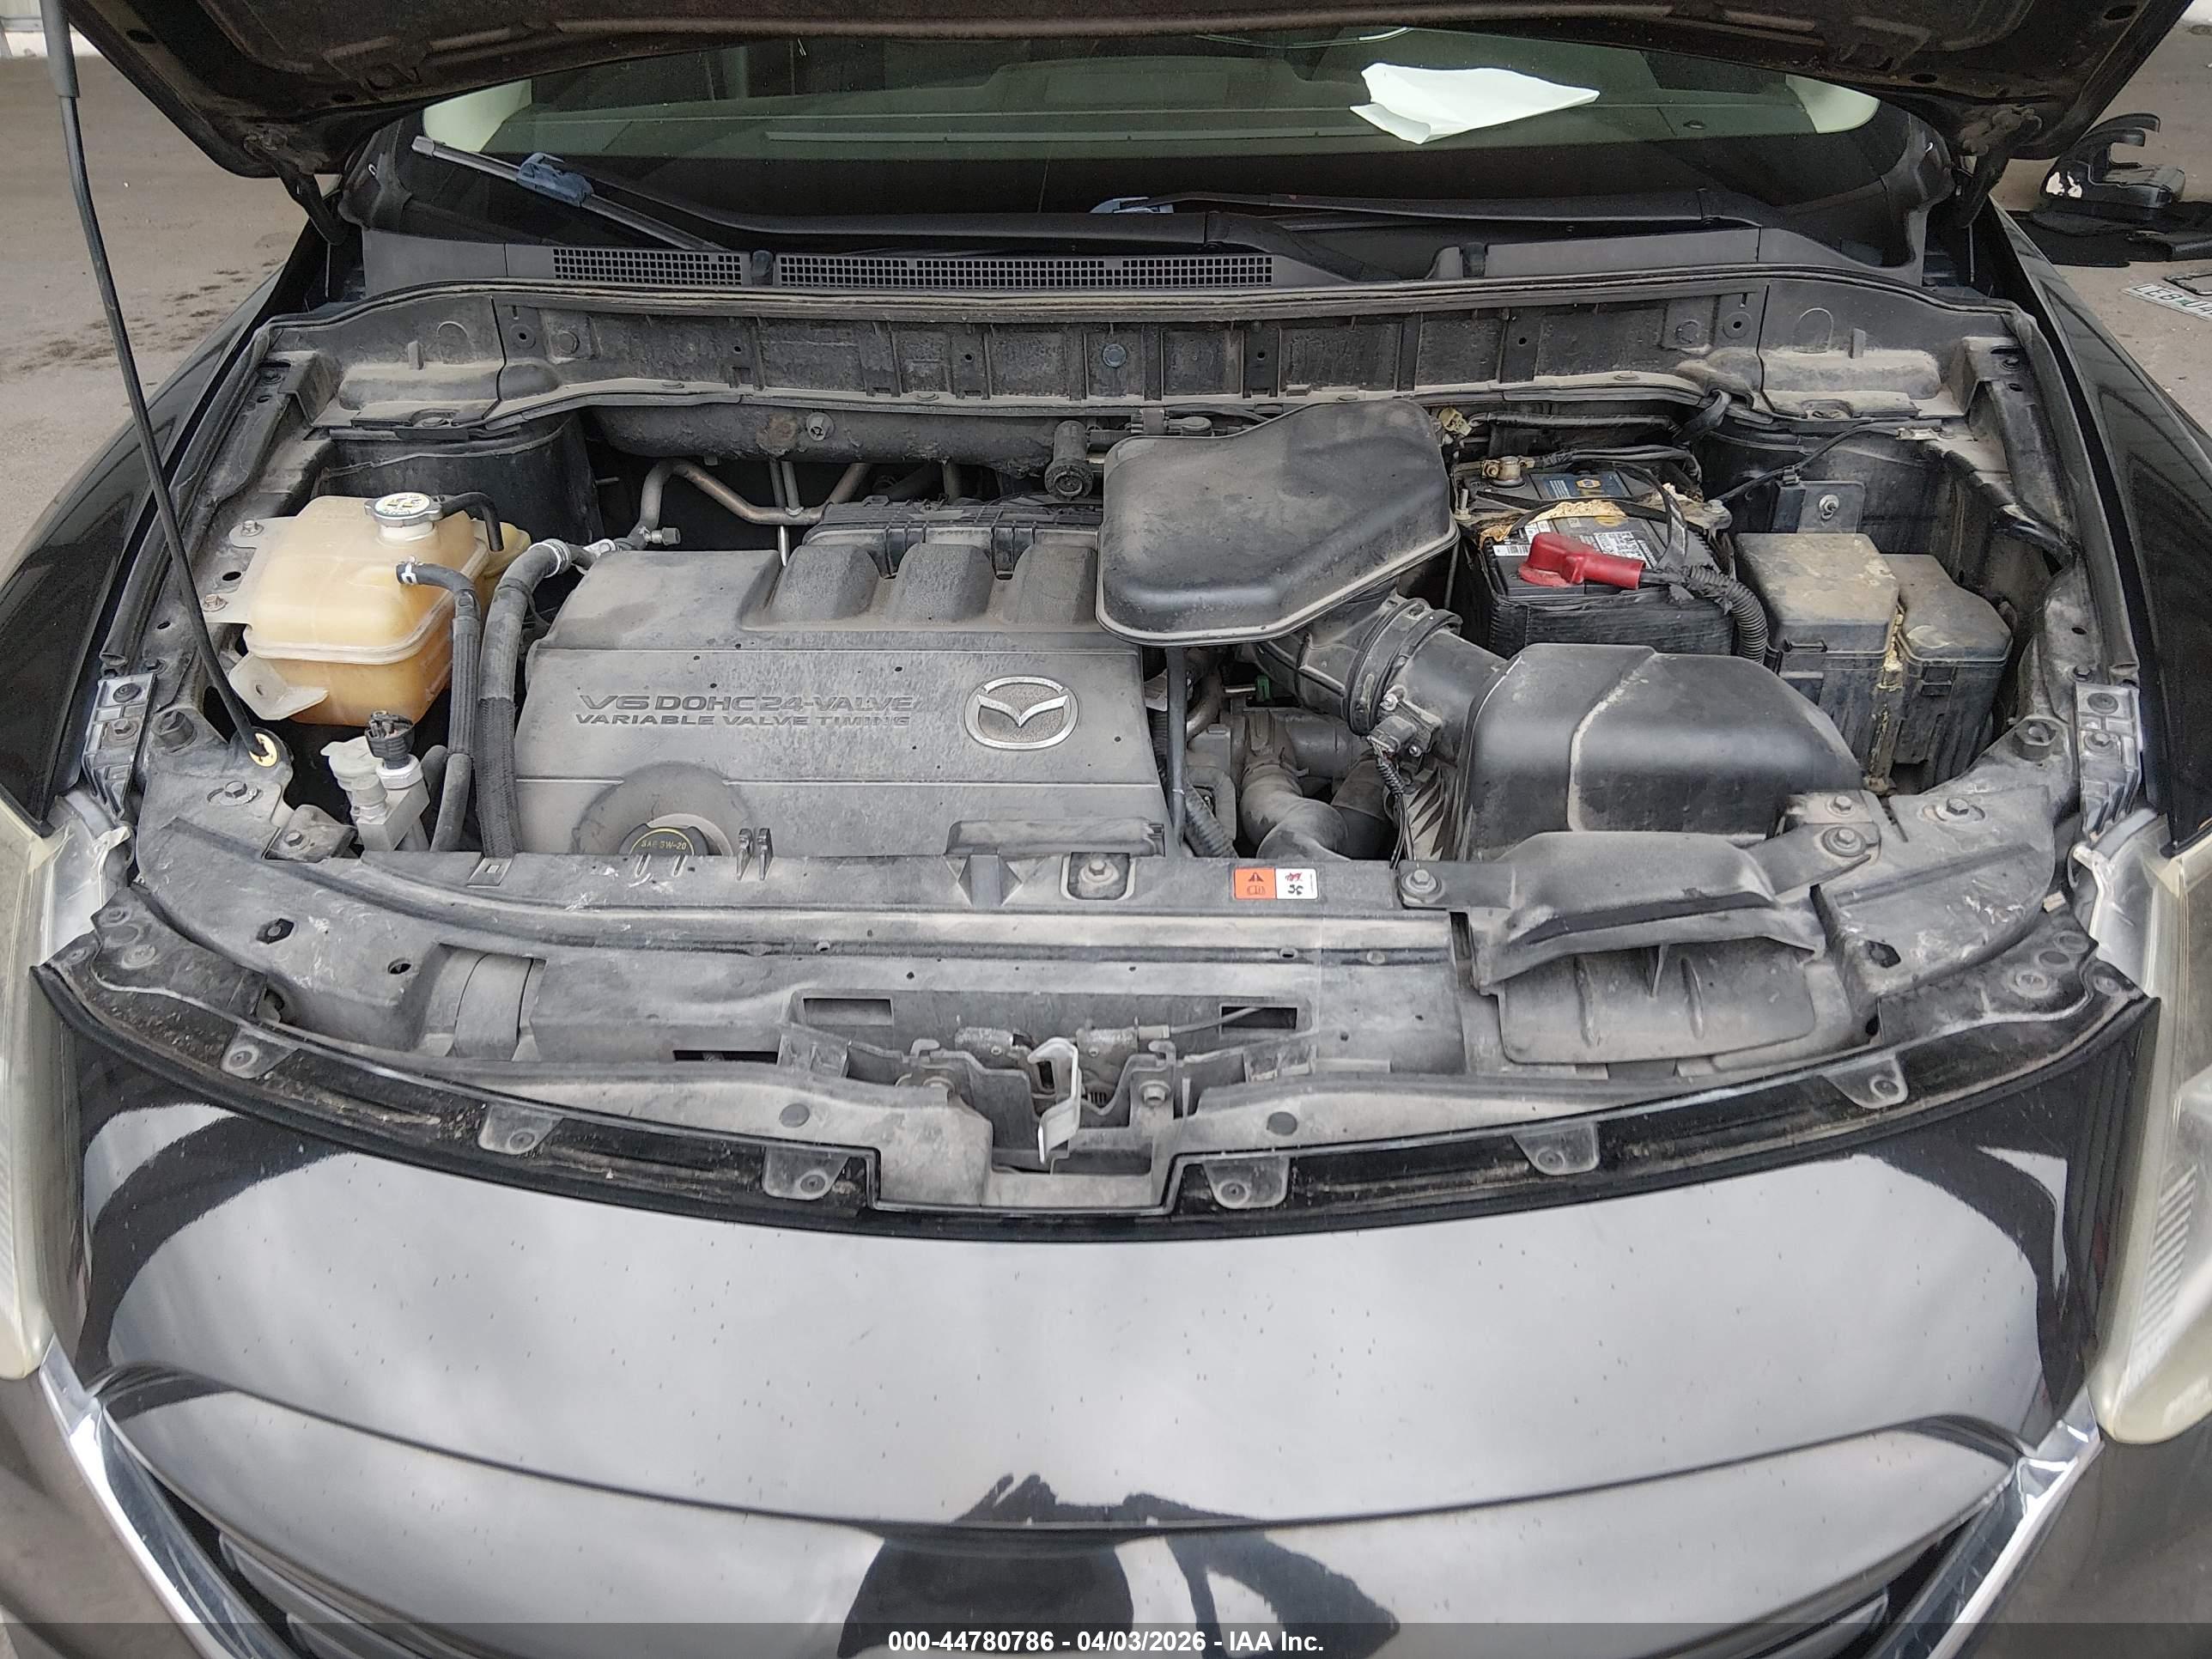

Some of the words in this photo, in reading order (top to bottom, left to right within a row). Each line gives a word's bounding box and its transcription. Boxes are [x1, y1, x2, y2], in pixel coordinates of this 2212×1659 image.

[580, 695, 651, 711] V6
[655, 696, 757, 711] DOHC
[760, 696, 915, 712] 24-VALVE
[575, 714, 715, 726] VARIABLE
[722, 715, 810, 726] VALVE
[816, 716, 911, 727] TIMING
[659, 841, 687, 850] 5W-20
